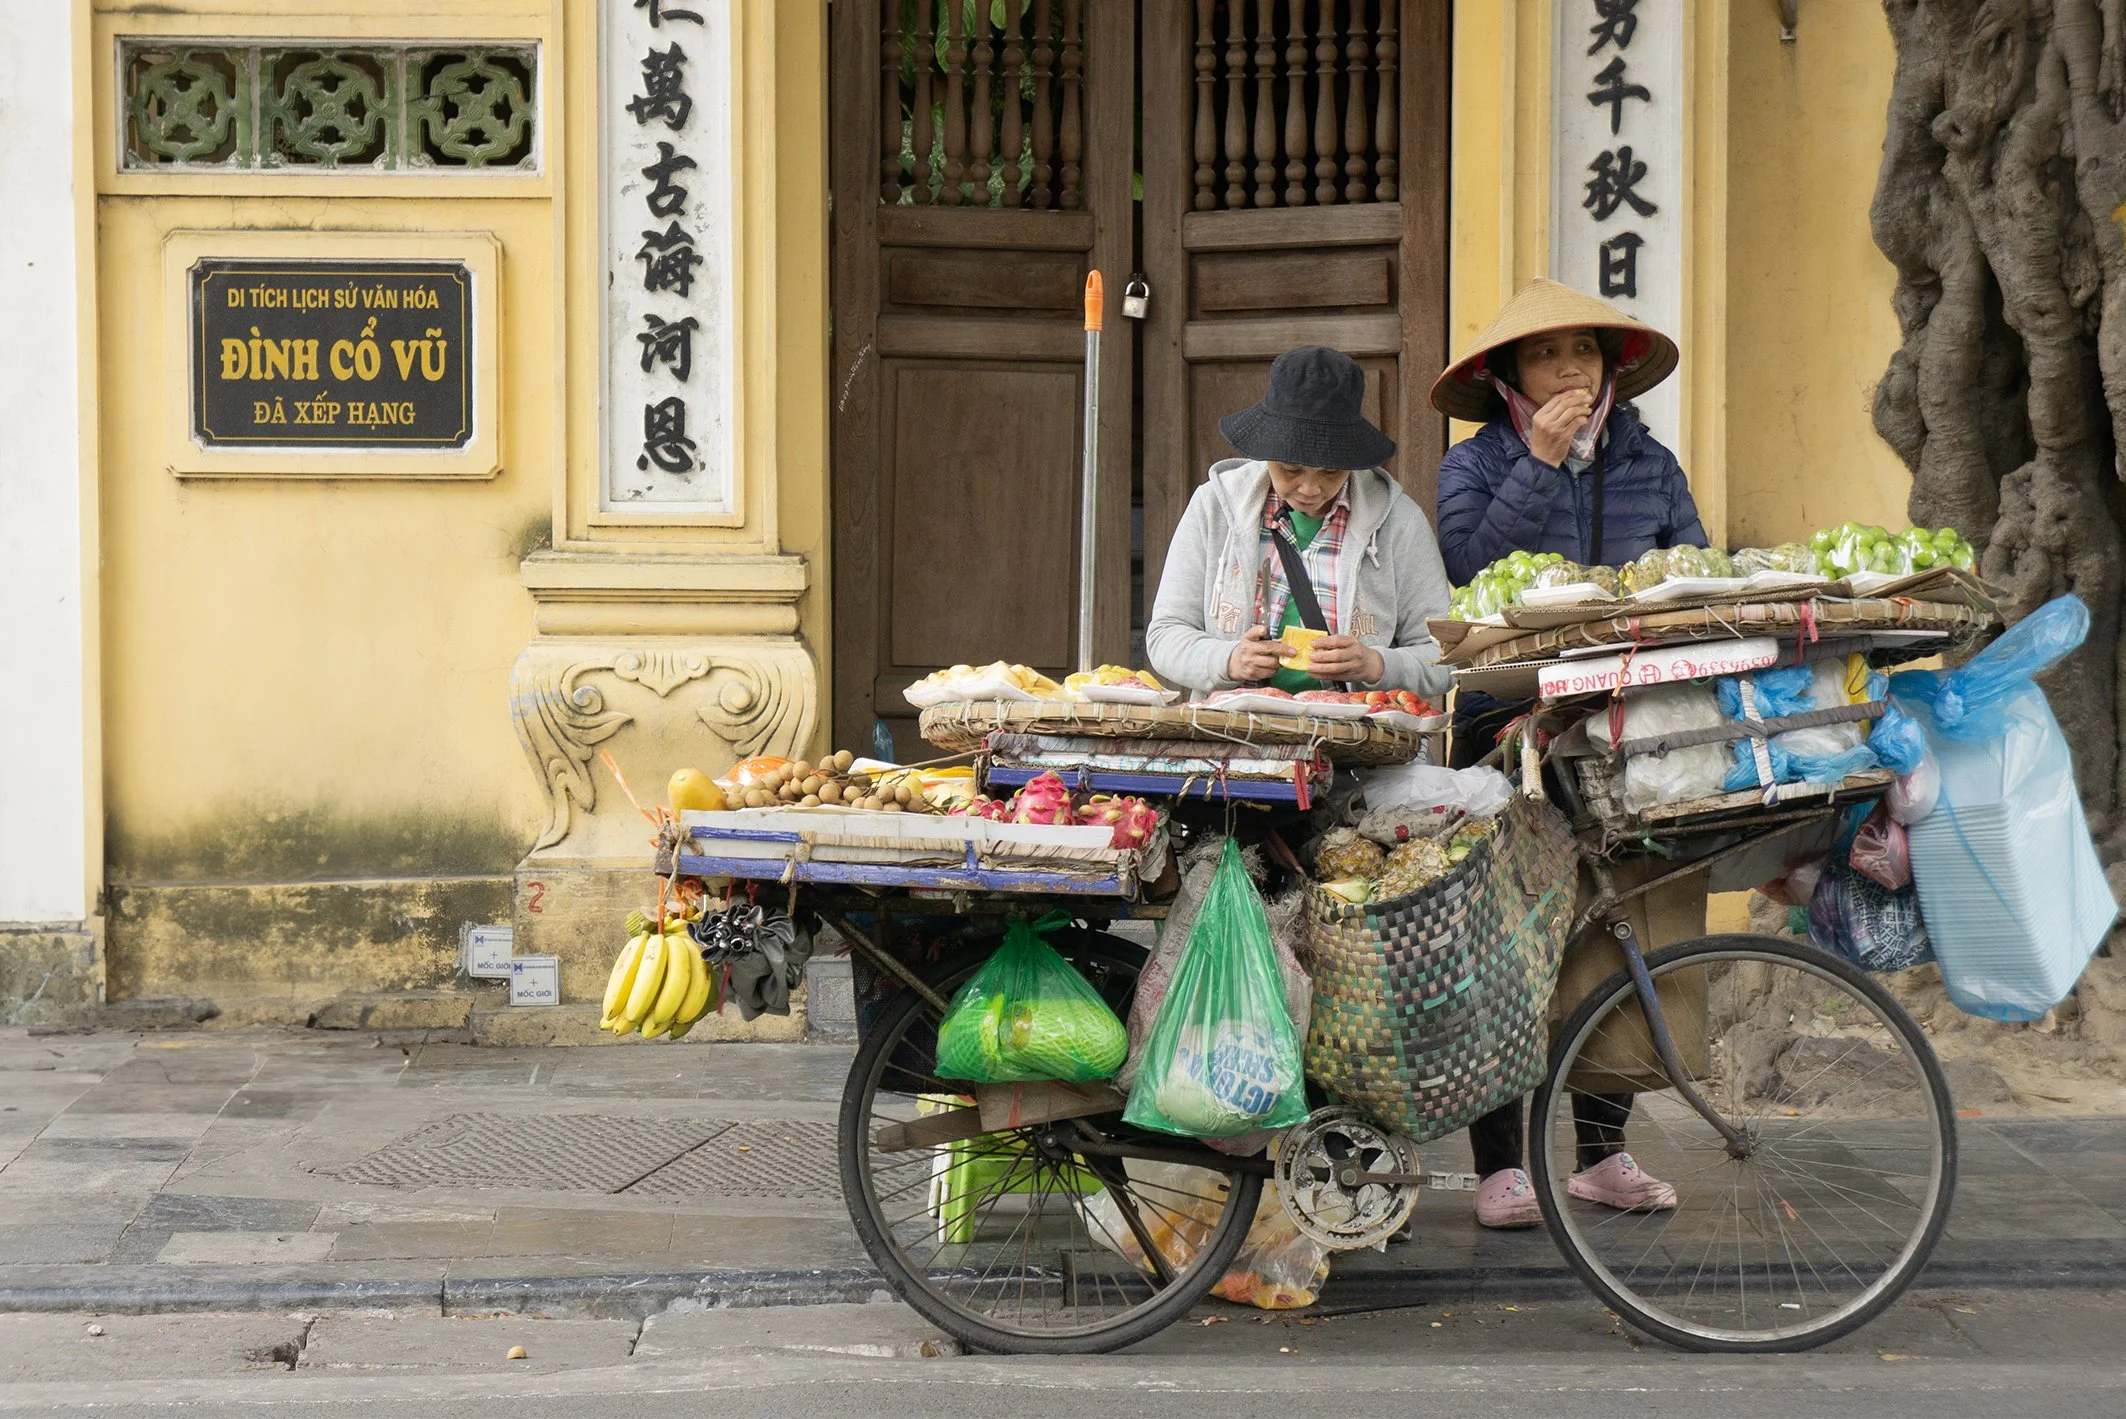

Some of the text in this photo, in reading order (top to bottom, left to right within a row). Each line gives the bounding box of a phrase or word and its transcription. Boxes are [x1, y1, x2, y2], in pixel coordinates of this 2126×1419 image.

[228, 282, 439, 313] DI TÍCH LỊCH SỬ VĂN HÓA
[220, 316, 447, 382] ĐÌNH CỔ VŨ
[254, 391, 416, 430] ĐÃ XẾP HẠNG
[527, 882, 545, 913] 2
